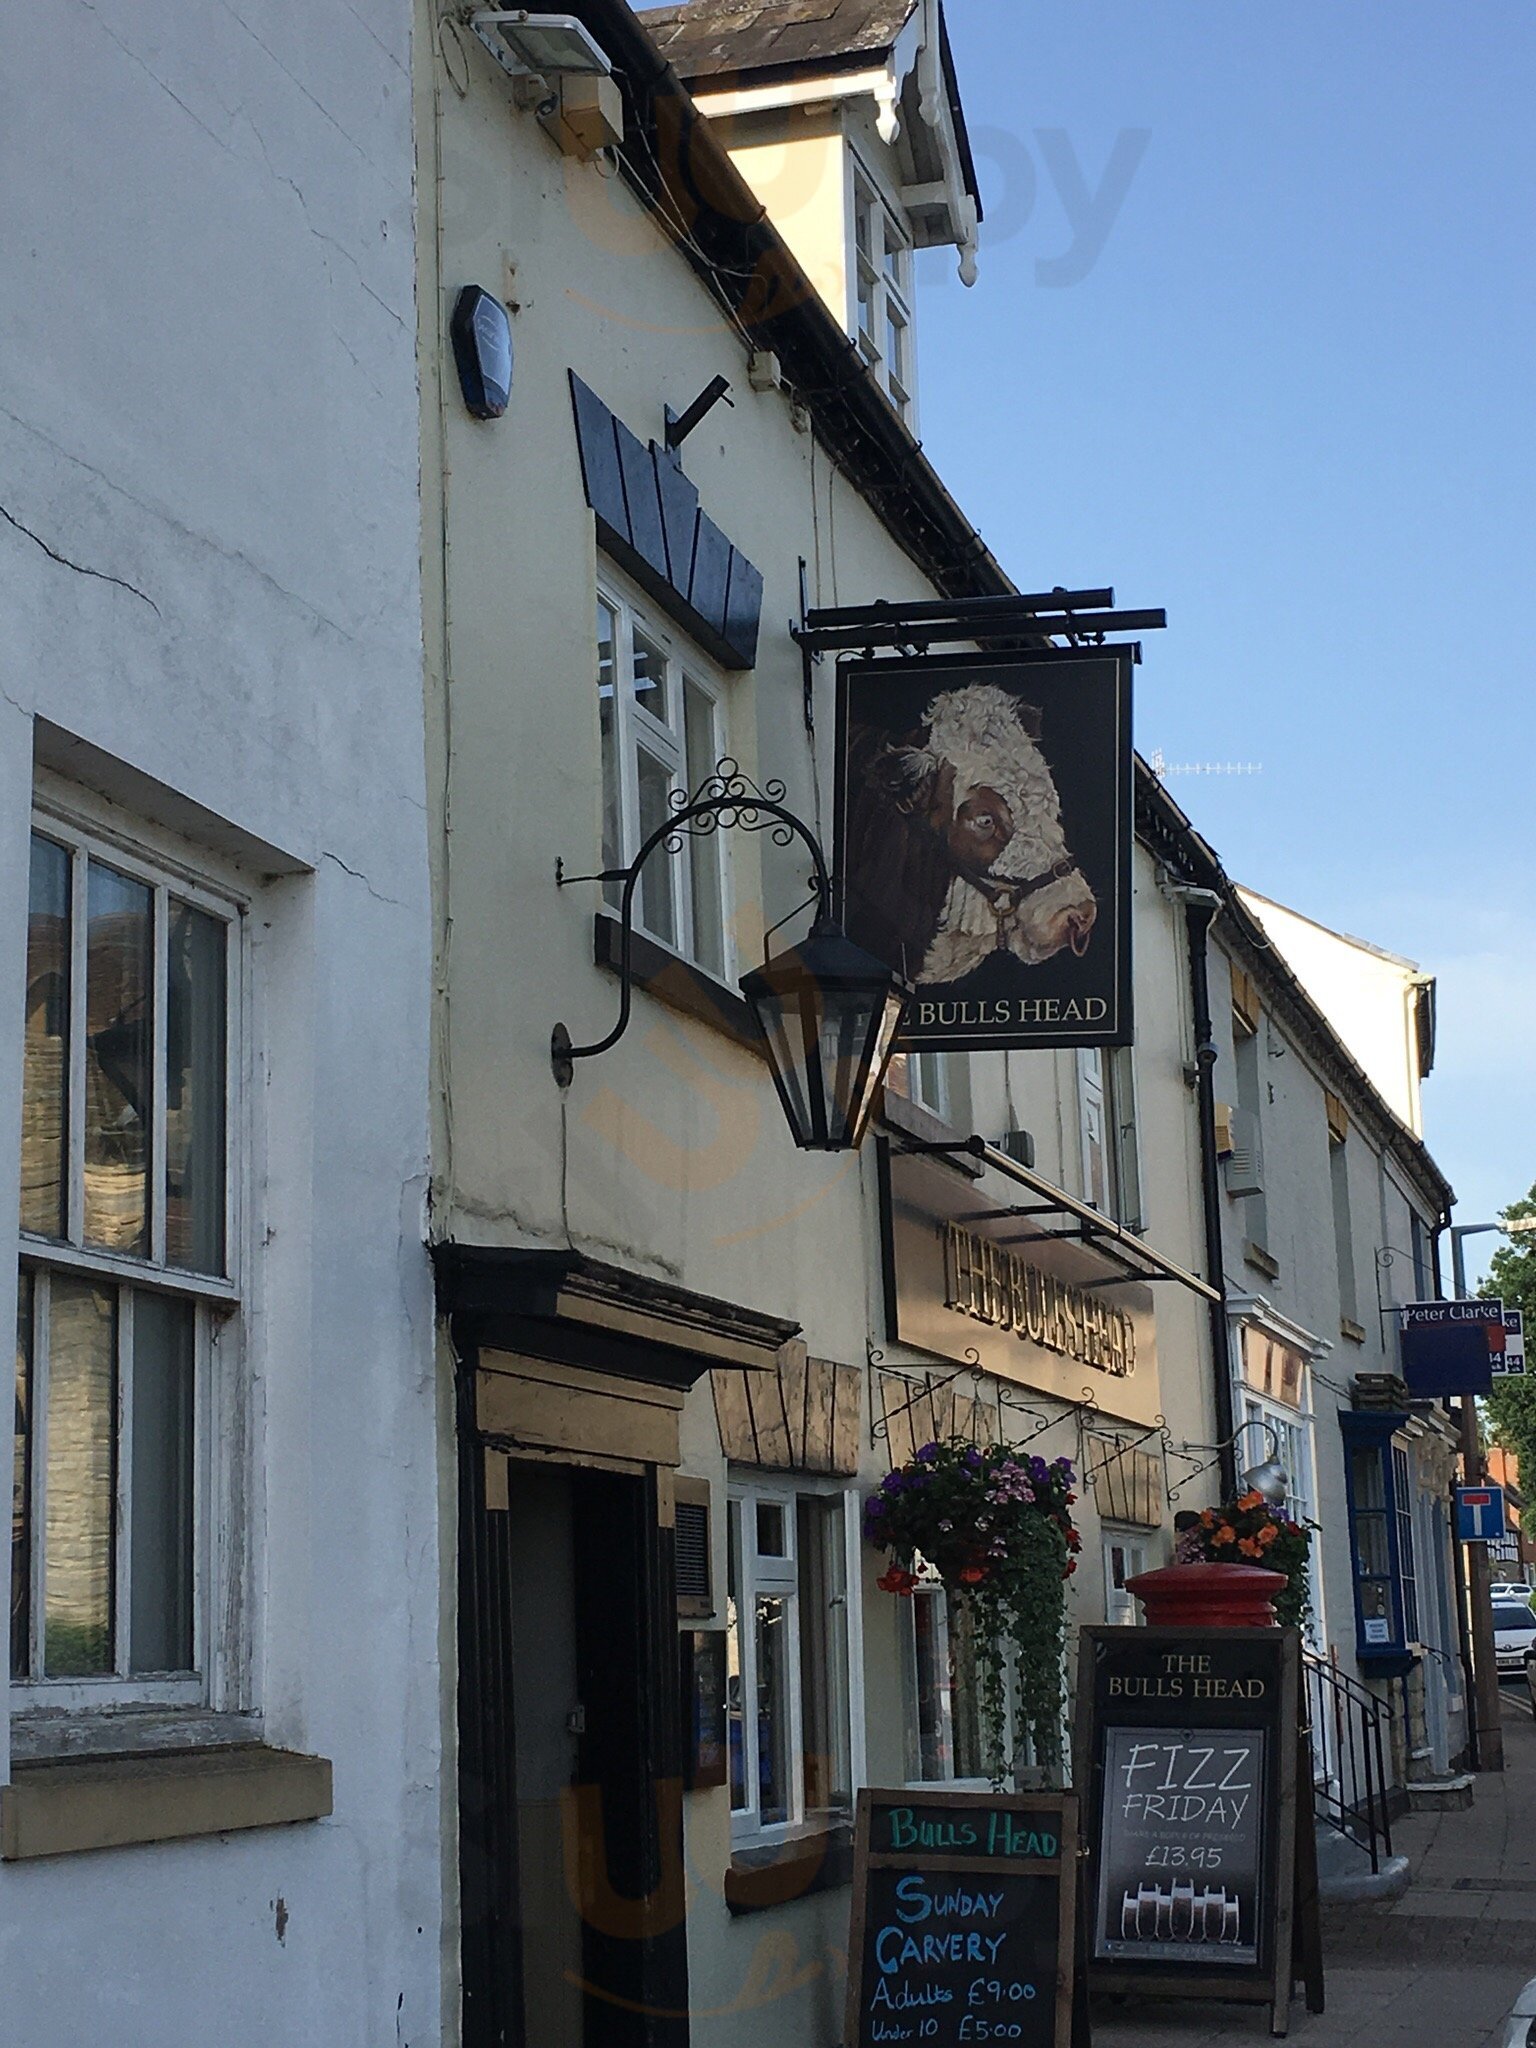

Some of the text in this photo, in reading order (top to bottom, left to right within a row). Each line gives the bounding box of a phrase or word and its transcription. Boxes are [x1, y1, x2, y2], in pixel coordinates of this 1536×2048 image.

[919, 1000, 1011, 1025] BULLS
[1019, 997, 1107, 1023] HEAD
[1406, 1305, 1498, 1322] Peter Clarke
[1161, 1654, 1211, 1674] THE
[1109, 1677, 1265, 1698] BULLS HEAD
[1121, 1743, 1252, 1791] FIZZ
[1122, 1793, 1249, 1830] FRIDAY
[889, 1807, 1058, 1858] BULLS HEAD
[1145, 1846, 1223, 1868] £13.95
[895, 1875, 1004, 1923] SUNDAY
[875, 1926, 1007, 1974] CARVERY
[870, 1976, 953, 2011] Adults
[919, 2017, 938, 2037] 10
